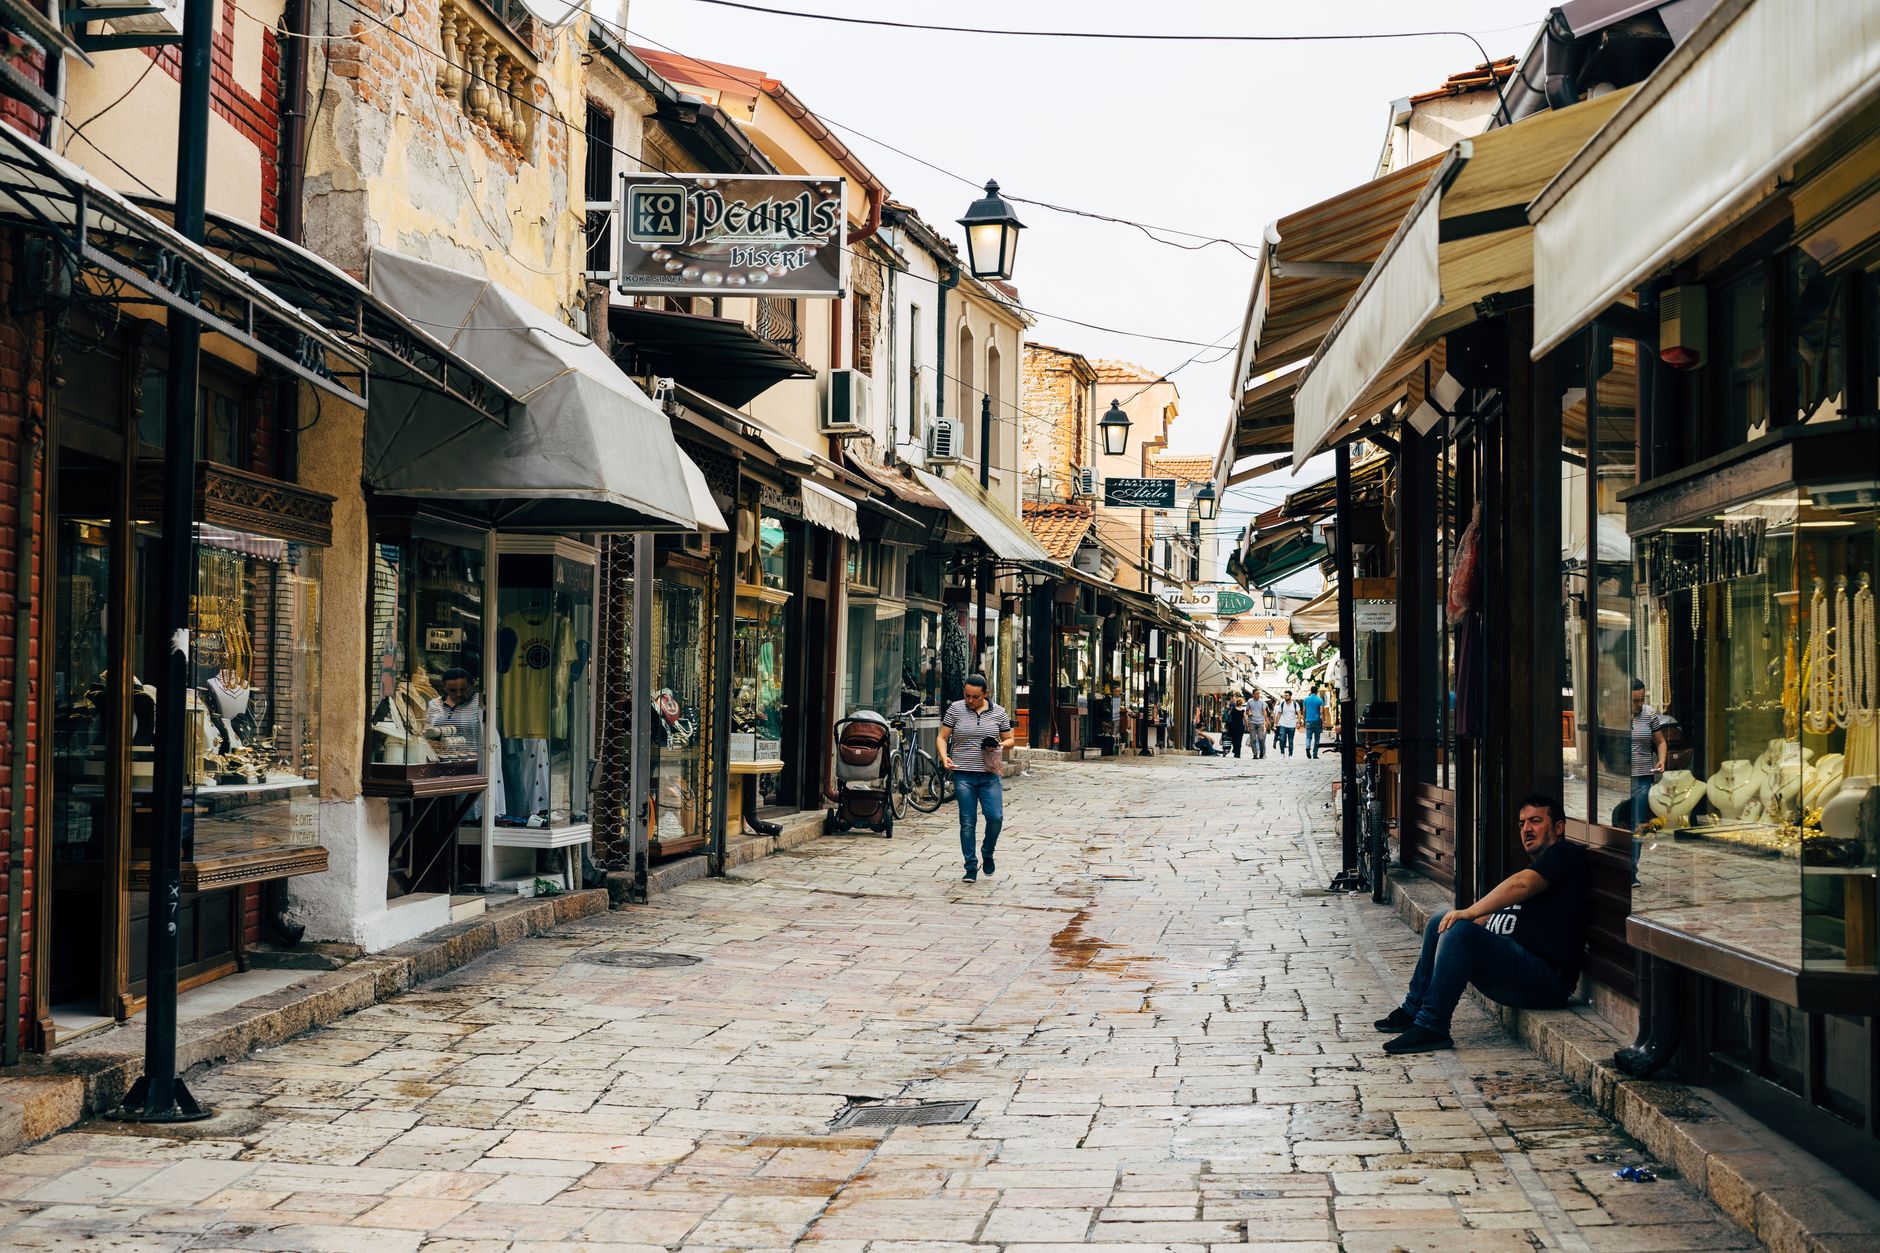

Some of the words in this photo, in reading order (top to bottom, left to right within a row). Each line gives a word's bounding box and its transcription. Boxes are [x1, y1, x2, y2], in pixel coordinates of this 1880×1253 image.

[688, 190, 839, 246] Pearls
[729, 245, 809, 270] biseri
[1112, 485, 1168, 498] Atila
[441, 642, 460, 650] ZLATO
